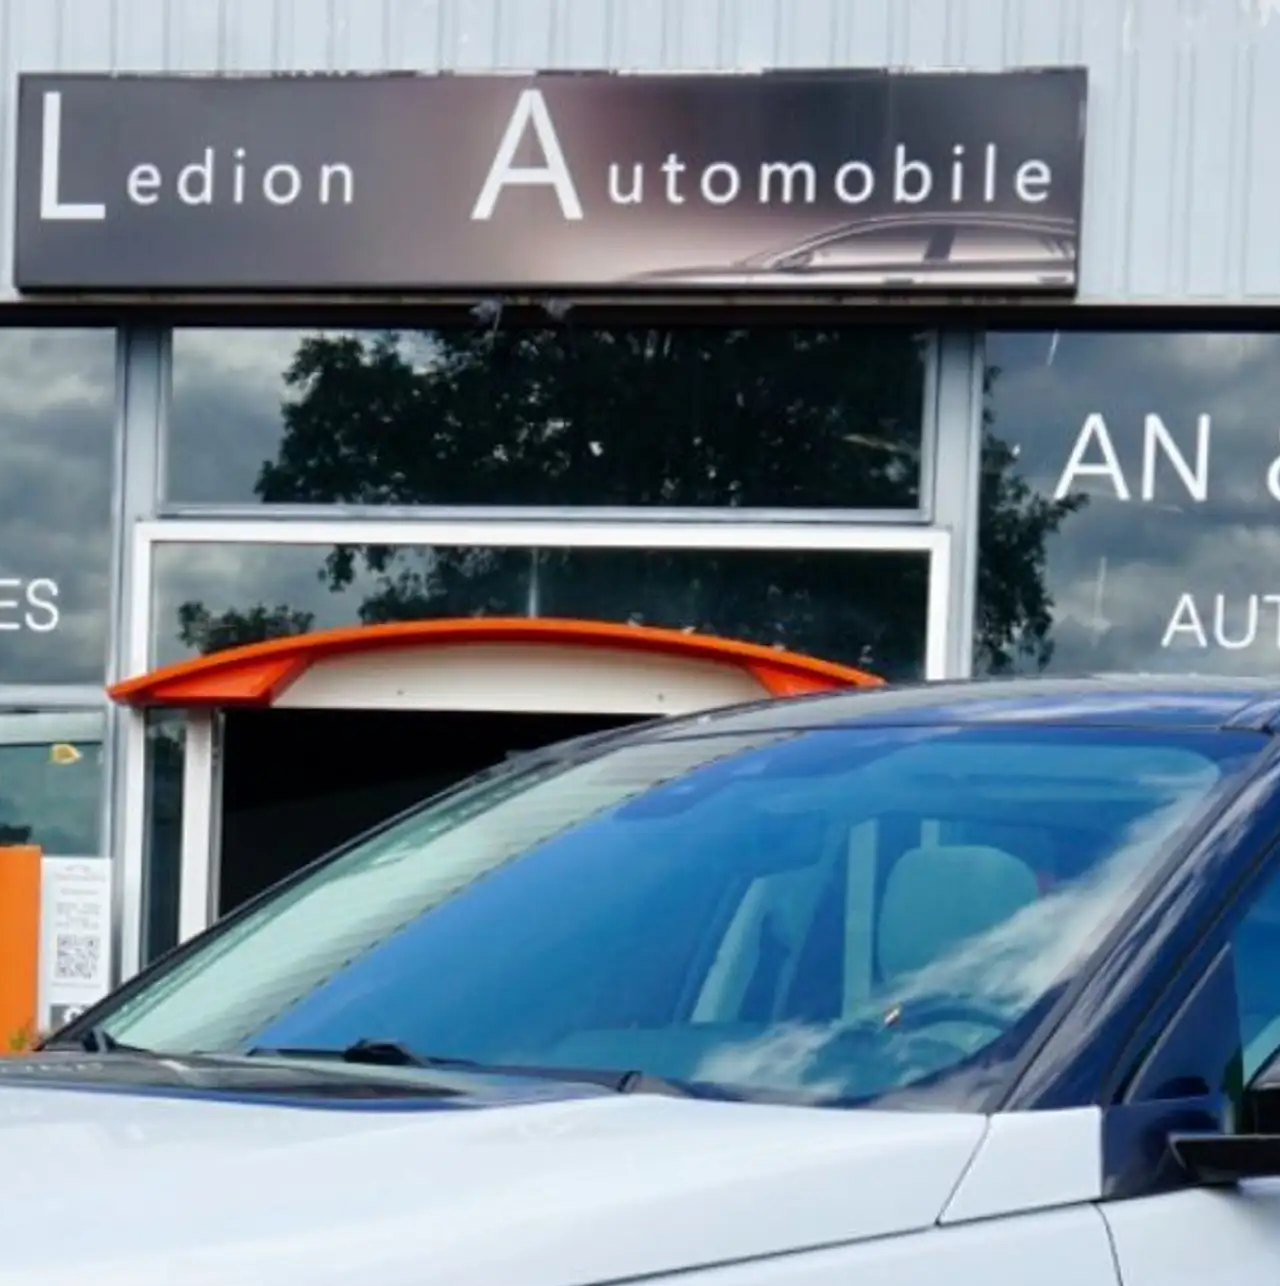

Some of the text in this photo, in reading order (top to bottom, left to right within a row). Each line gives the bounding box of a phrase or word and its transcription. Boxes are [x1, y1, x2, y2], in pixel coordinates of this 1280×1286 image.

[39, 88, 1051, 221] Ledion Automobile
[1054, 413, 1210, 502] AN
